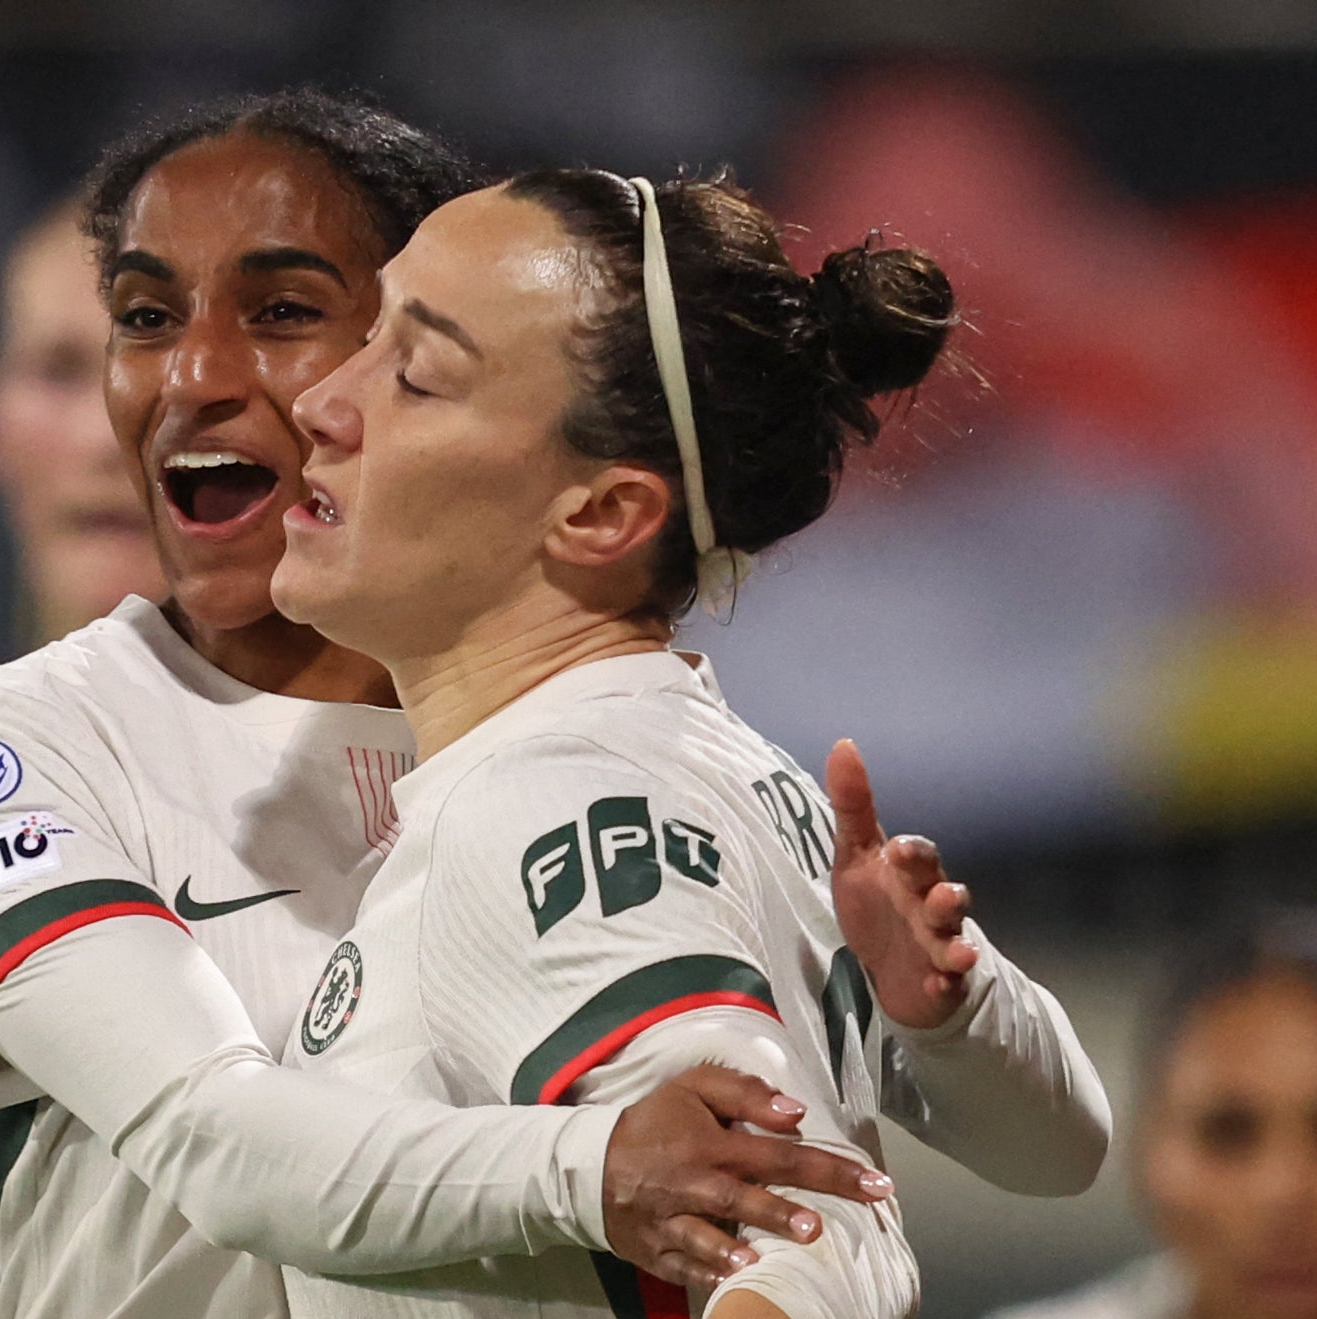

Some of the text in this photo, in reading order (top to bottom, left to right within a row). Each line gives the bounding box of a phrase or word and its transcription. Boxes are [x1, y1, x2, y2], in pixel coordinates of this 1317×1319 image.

[524, 818, 717, 912] FPT
[751, 769, 837, 881] BR
[331, 942, 362, 973] CHELSEA
